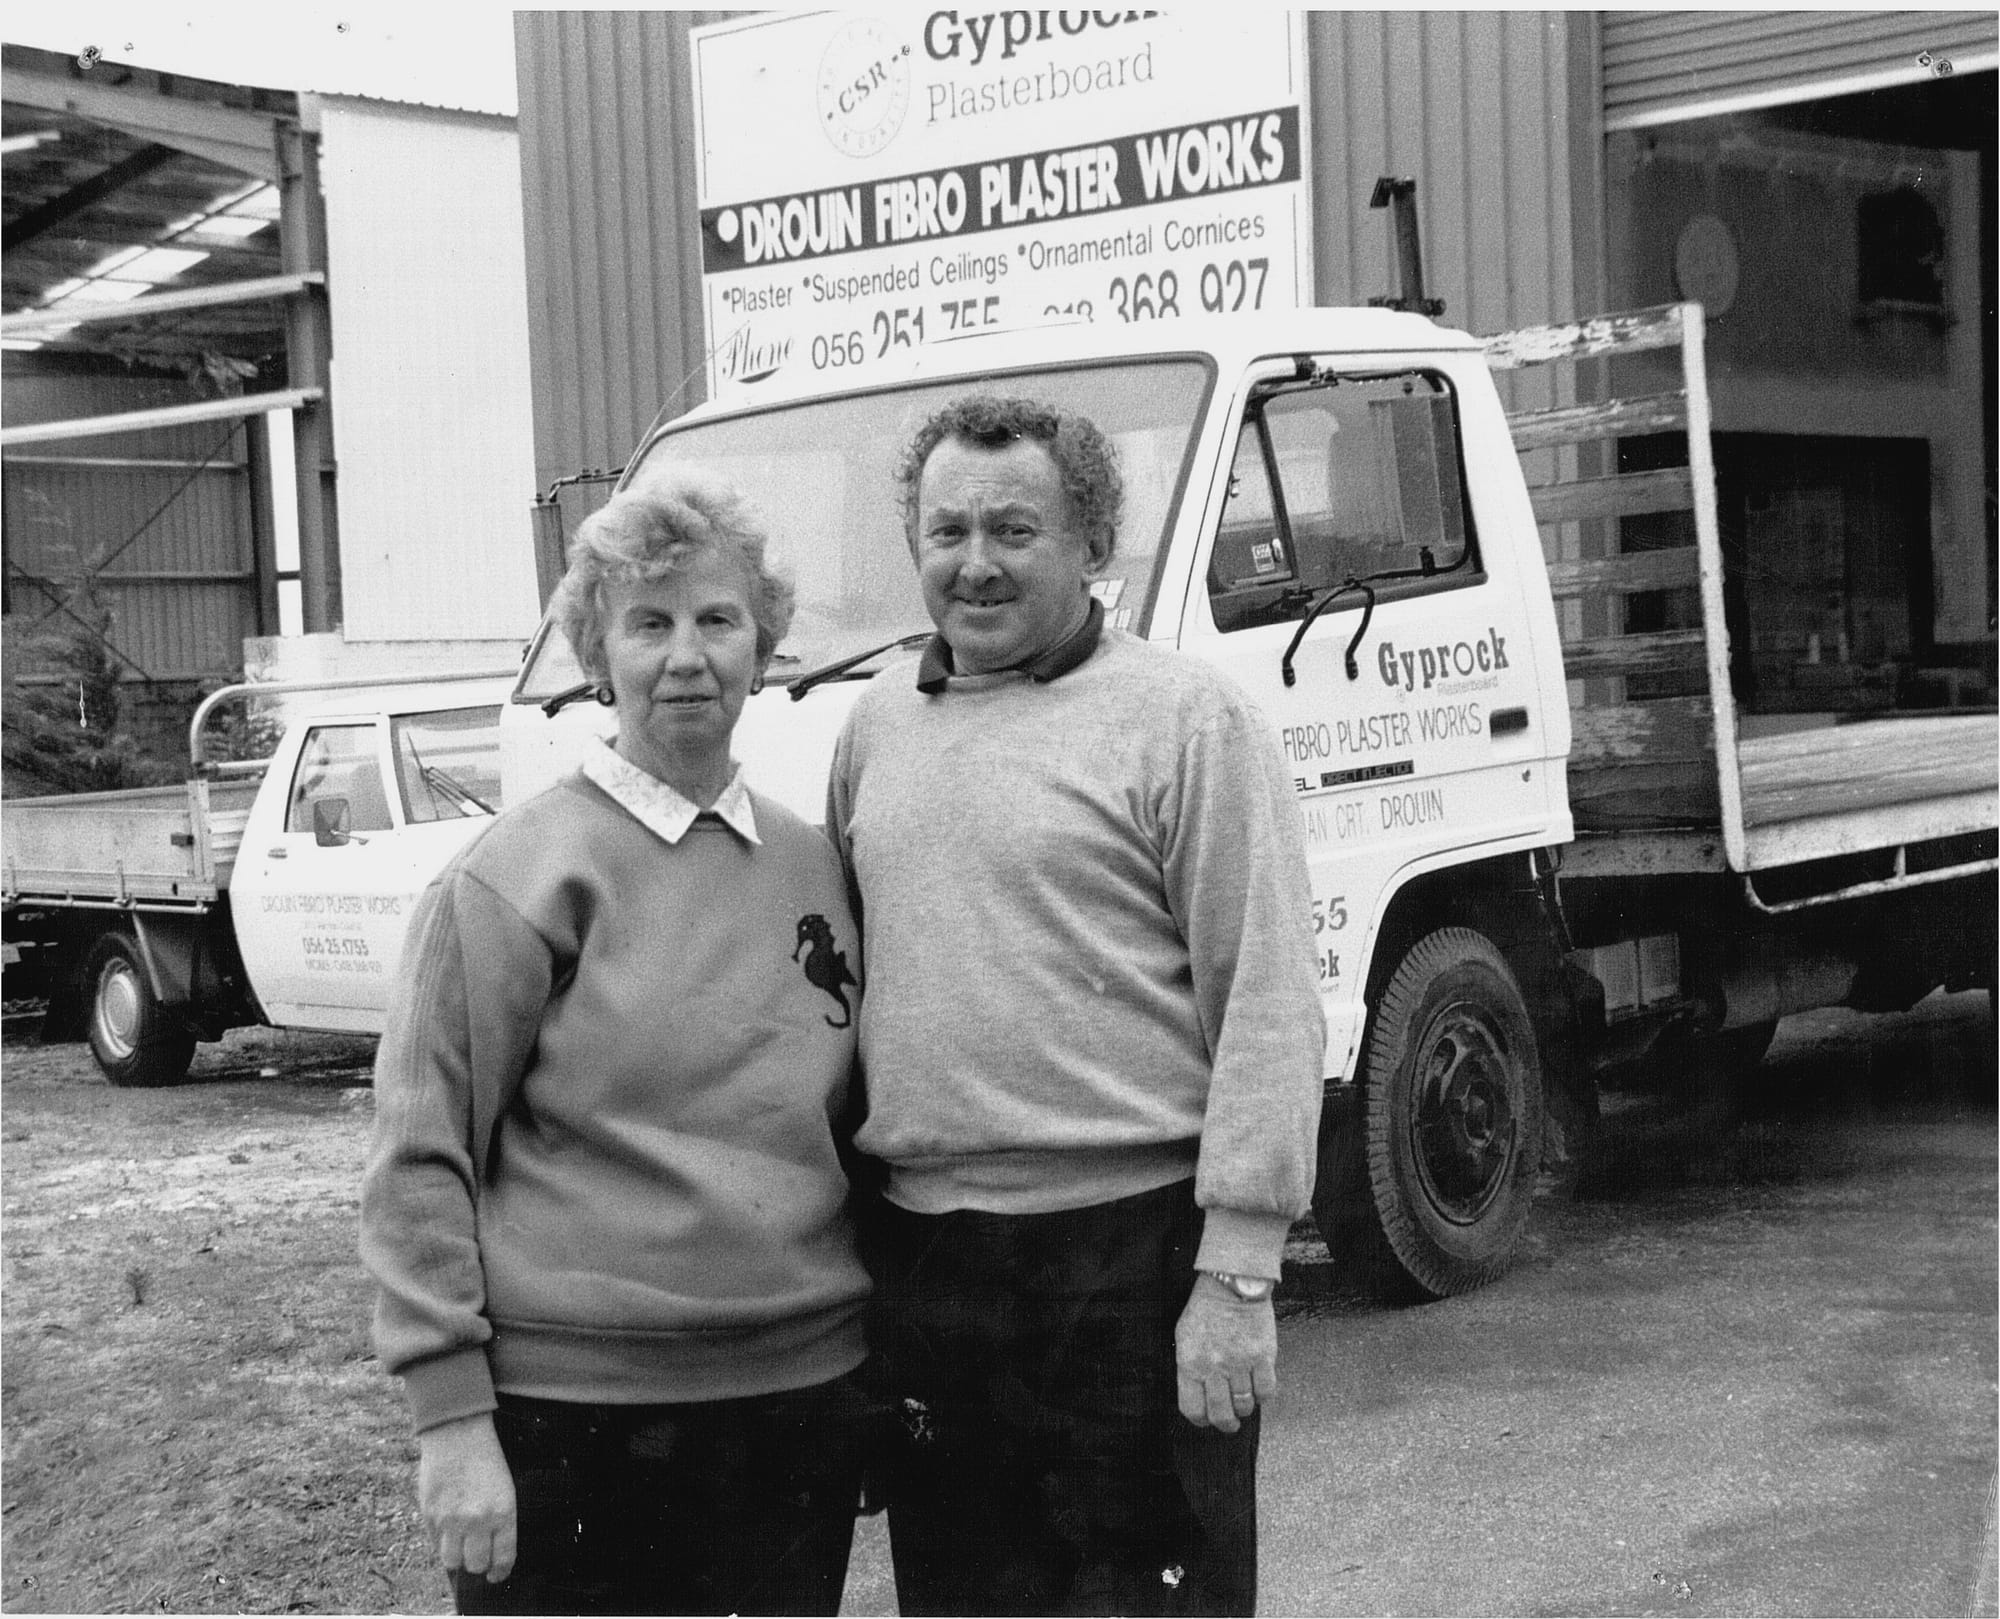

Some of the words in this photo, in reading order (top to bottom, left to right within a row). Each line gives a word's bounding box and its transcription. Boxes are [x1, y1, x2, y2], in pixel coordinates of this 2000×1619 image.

[838, 61, 887, 114] CSR
[926, 42, 1154, 124] Plasterboard
[741, 188, 863, 264] DROUIN
[874, 171, 968, 244] FIBRO
[979, 144, 1122, 227] PLASTER
[1135, 113, 1285, 200] WORKS
[730, 285, 794, 314] Plaster
[811, 261, 920, 303] Suspended
[929, 250, 1009, 287] Ceilings
[1028, 223, 1153, 271] Ornamental
[1164, 212, 1265, 252] Cornices
[811, 330, 865, 370] 056
[1108, 269, 1181, 324] 368
[1199, 257, 1269, 314] 927
[1377, 627, 1510, 692] Gyprock
[1282, 722, 1331, 762] FIBRO
[1336, 712, 1413, 754] PLASTER
[1416, 702, 1482, 743] WORKS
[1380, 787, 1444, 831] DROUIN
